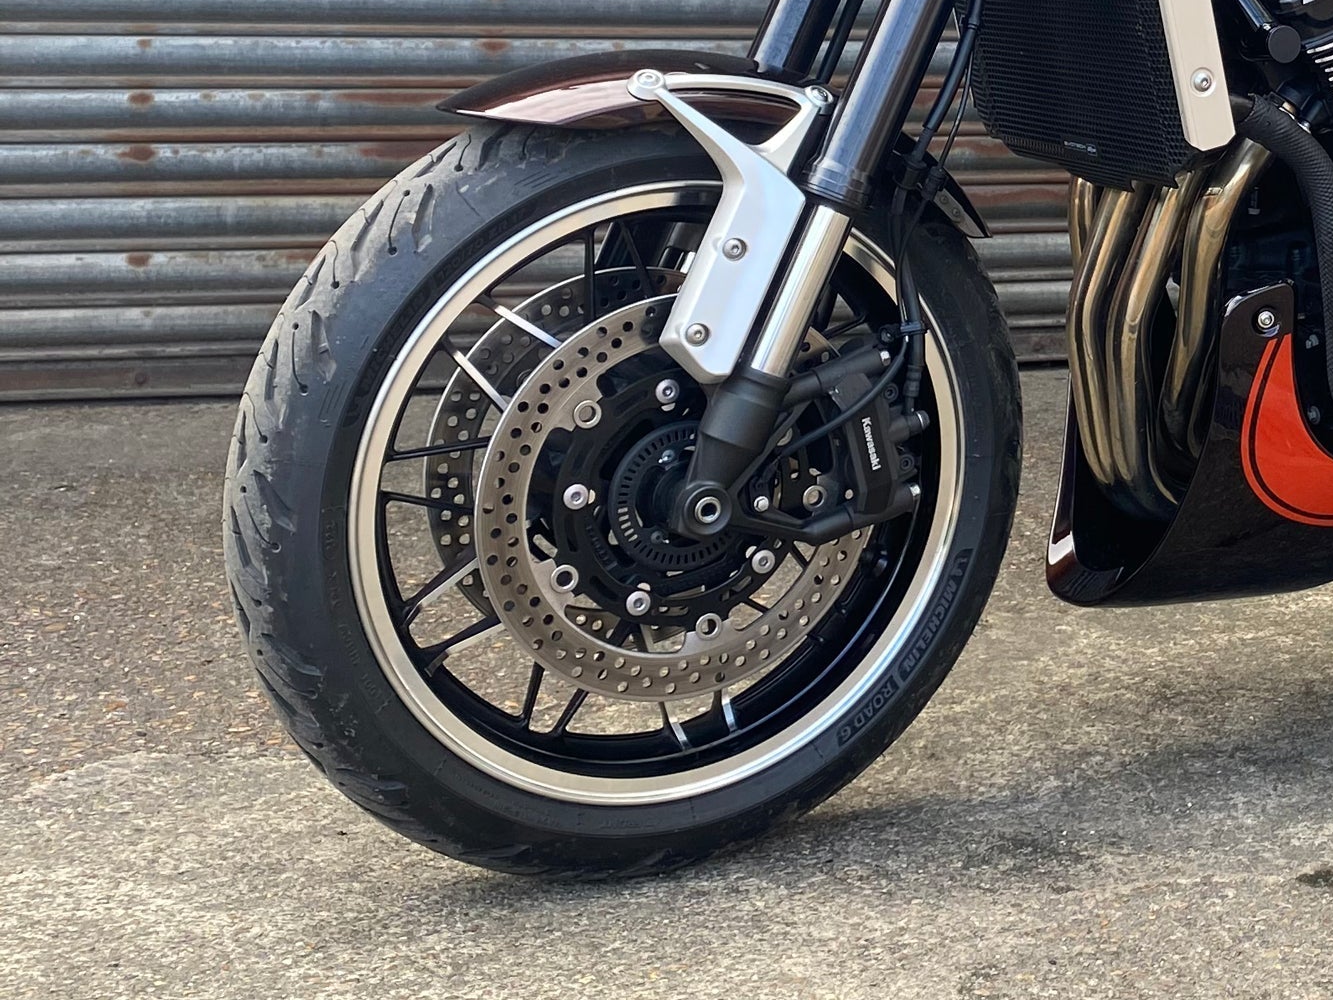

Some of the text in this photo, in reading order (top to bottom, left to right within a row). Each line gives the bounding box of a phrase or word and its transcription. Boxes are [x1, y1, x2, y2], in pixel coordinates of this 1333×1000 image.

[862, 417, 881, 470] Kawasaki
[904, 582, 958, 673] MICHELIN
[854, 682, 895, 726] ROAD
